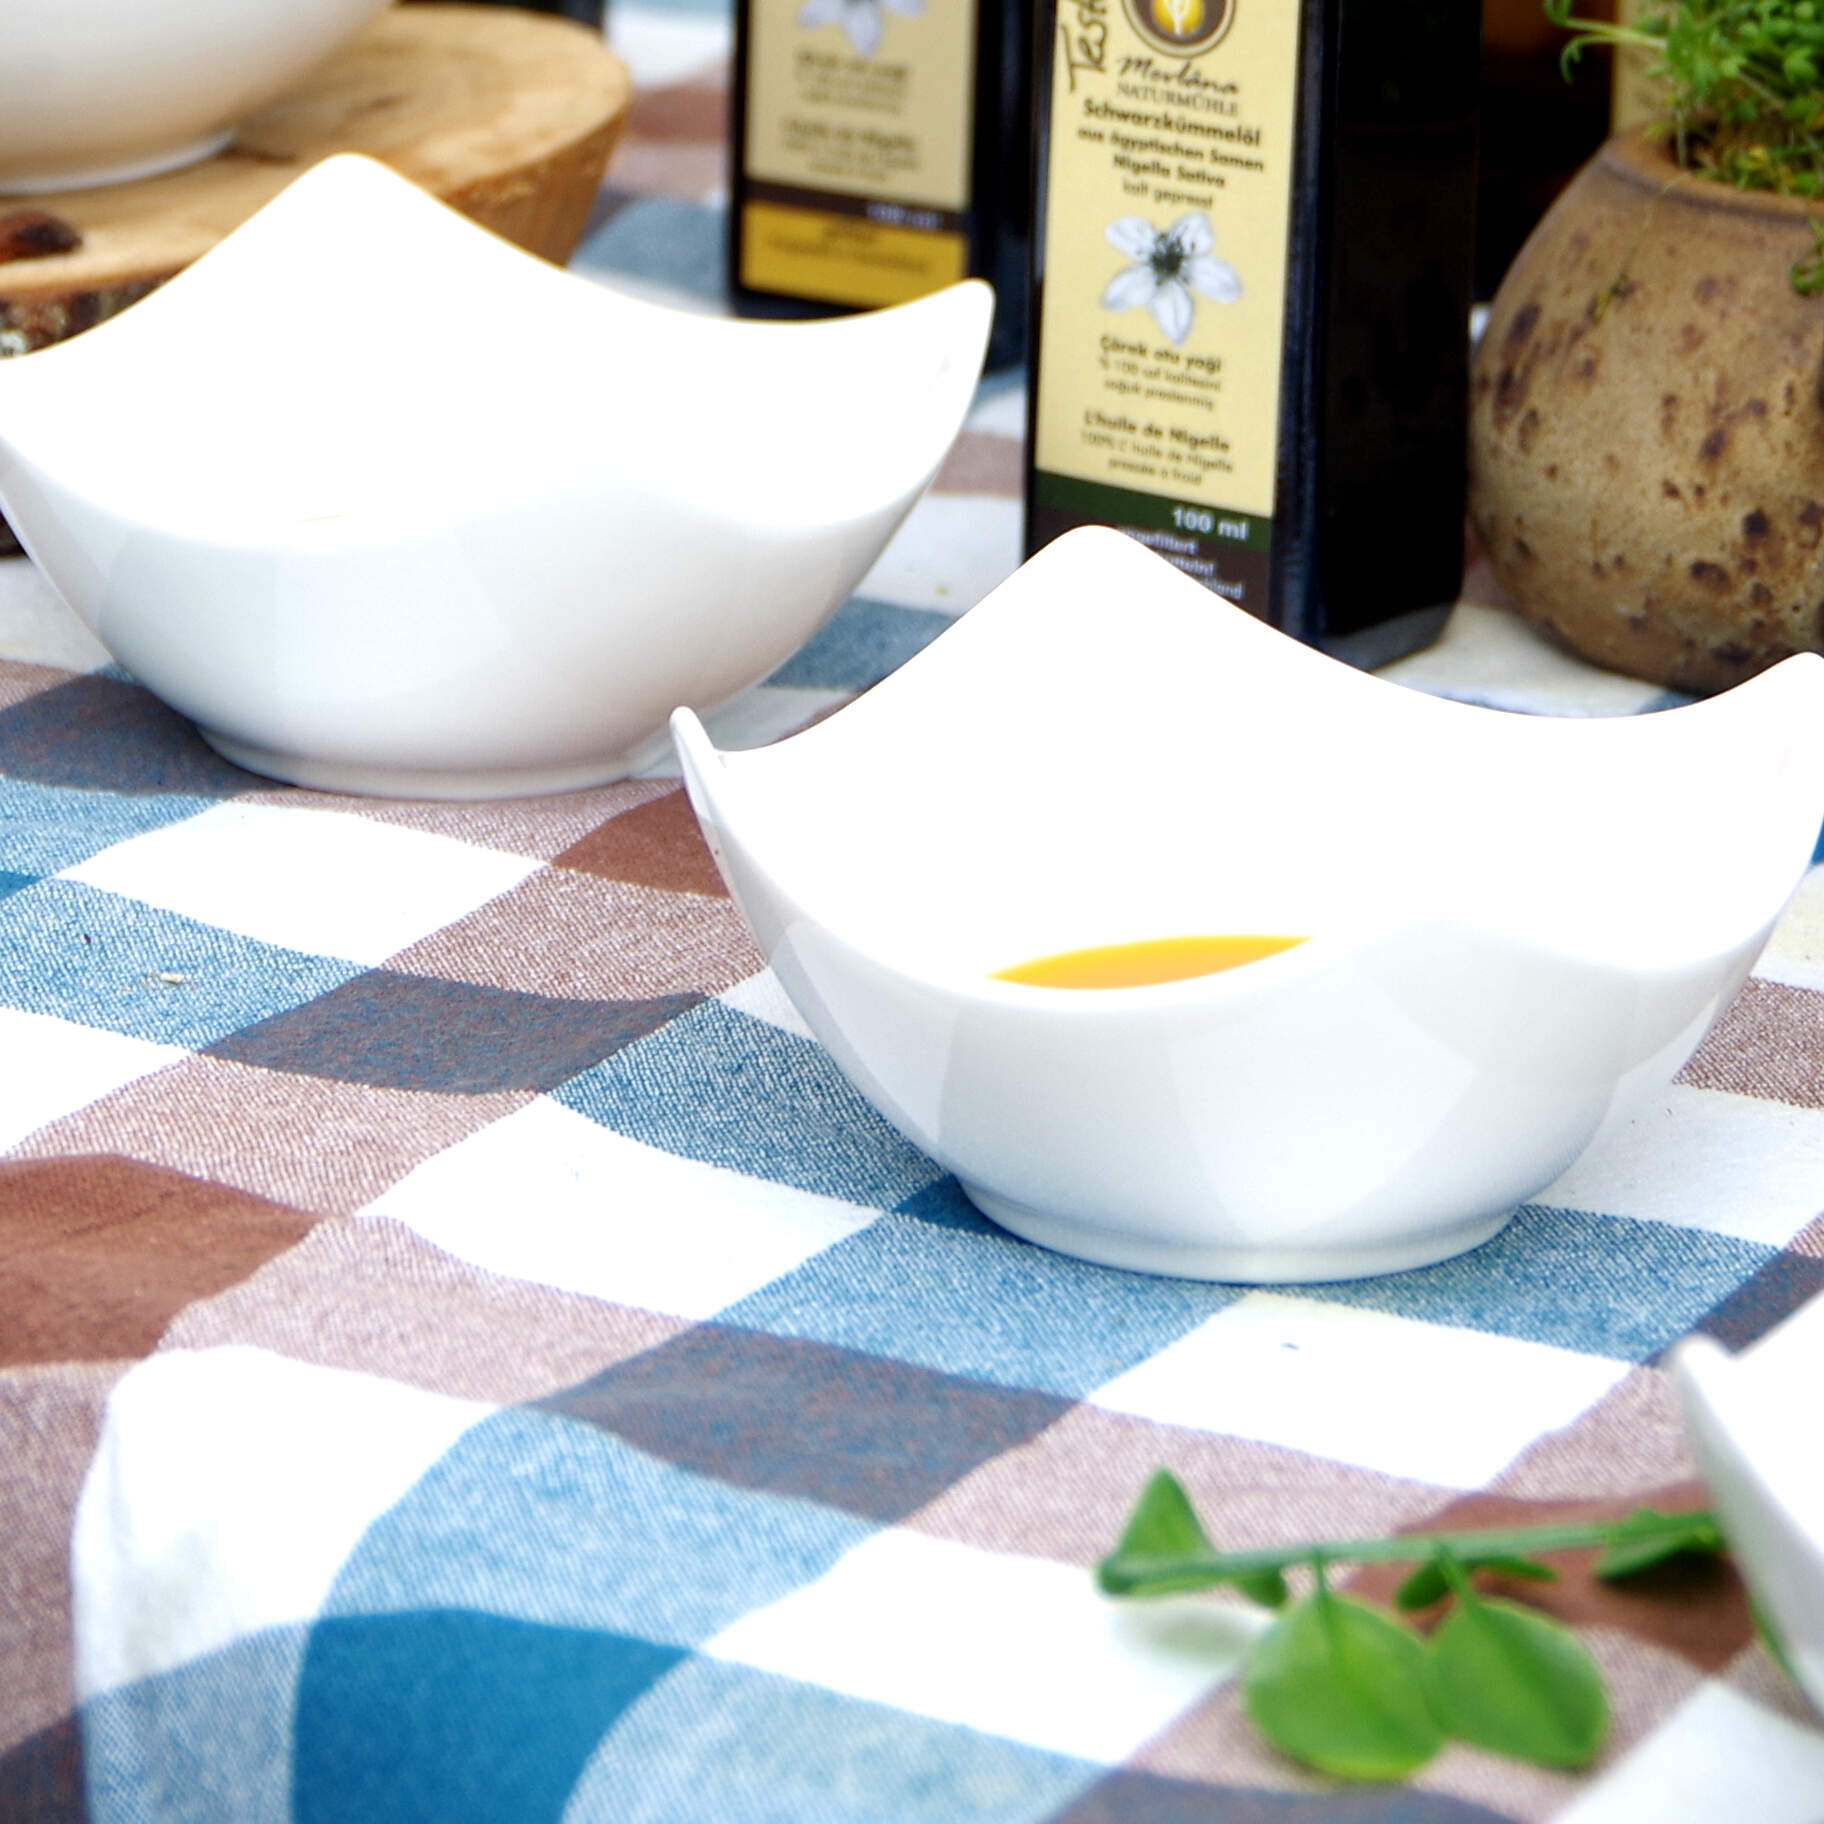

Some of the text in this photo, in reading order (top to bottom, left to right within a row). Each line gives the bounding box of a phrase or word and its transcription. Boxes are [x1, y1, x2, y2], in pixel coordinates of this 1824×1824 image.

[1083, 97, 1262, 147] Schwarzkümmelöl
[1210, 149, 1265, 173] Samen
[1172, 507, 1250, 541] 100 ml
